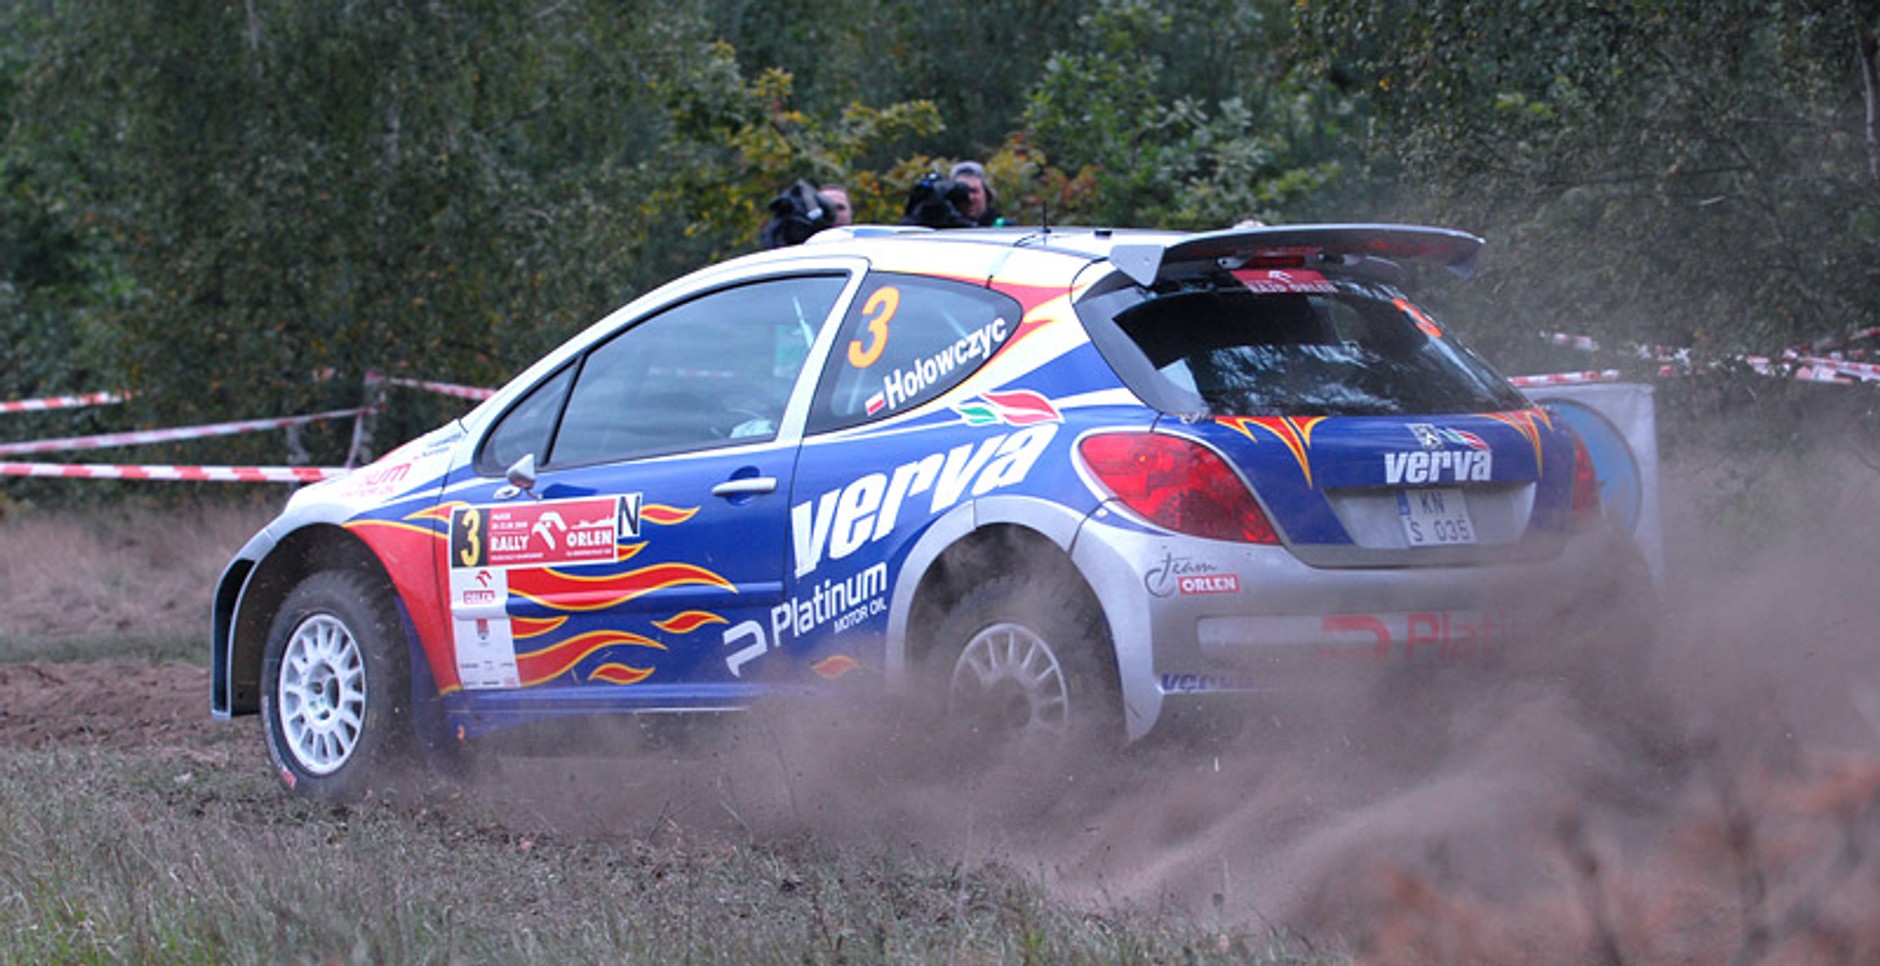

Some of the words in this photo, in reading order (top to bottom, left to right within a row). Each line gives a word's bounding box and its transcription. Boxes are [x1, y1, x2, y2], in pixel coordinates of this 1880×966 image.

[848, 286, 900, 368] 3
[1384, 450, 1492, 483] verva
[618, 496, 640, 535] N
[791, 423, 1058, 578] verva
[1421, 491, 1445, 514] KN
[461, 508, 481, 567] 3
[490, 535, 530, 551] RALLY
[566, 531, 613, 547] ORLEN
[1409, 522, 1424, 542] S
[1434, 519, 1471, 542] 035
[1181, 578, 1236, 592] ORLEN
[770, 562, 887, 648] Platinum
[833, 607, 868, 634] MOTOR
[869, 597, 887, 617] OIL
[1161, 673, 1253, 690] verv
